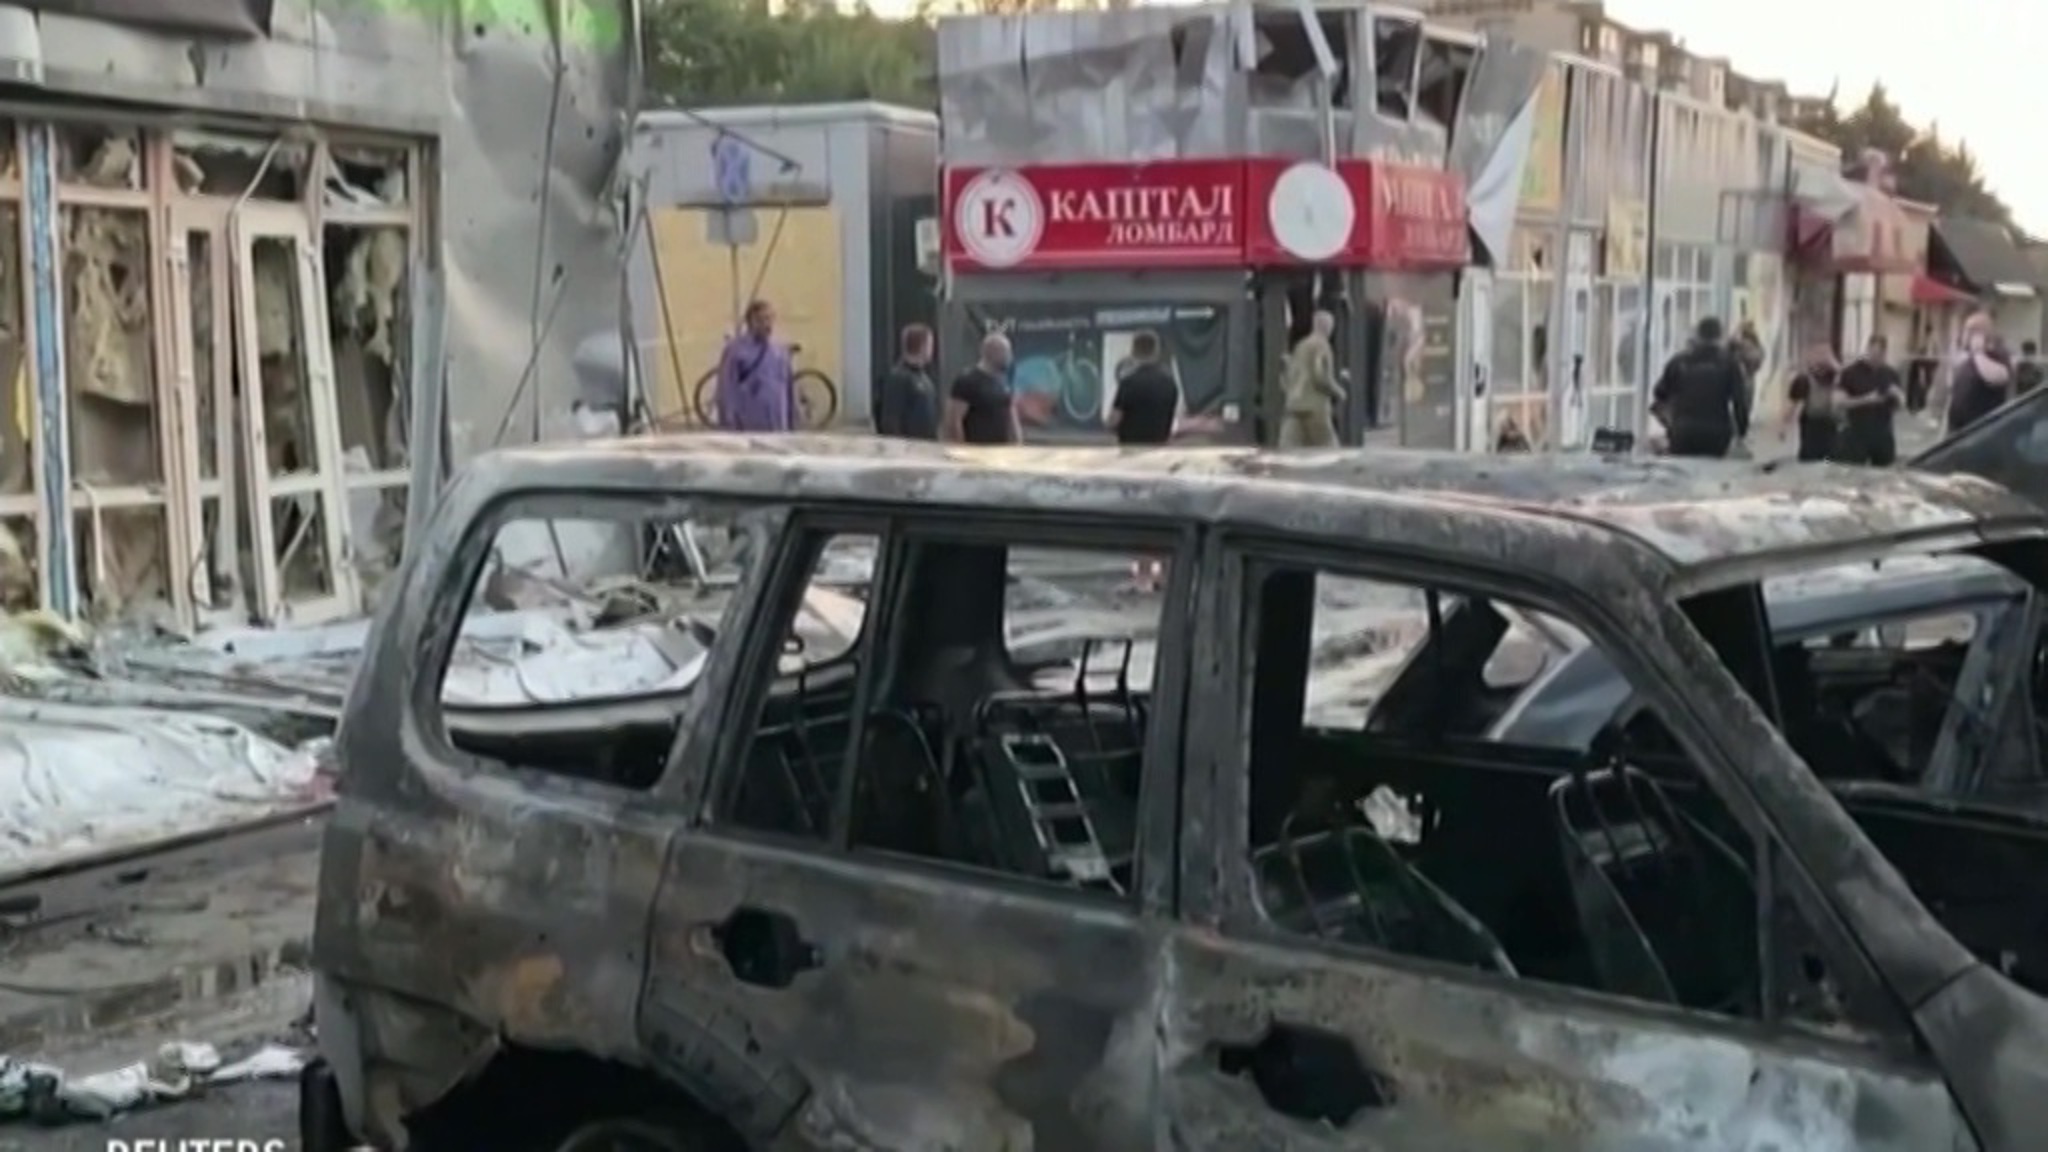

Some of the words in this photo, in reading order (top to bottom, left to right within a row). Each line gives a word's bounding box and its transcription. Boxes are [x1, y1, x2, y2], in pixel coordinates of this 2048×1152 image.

[983, 198, 1016, 237] К
[1049, 185, 1233, 221] КАПІТАЛ
[1105, 219, 1235, 245] ЛОМБАРД
